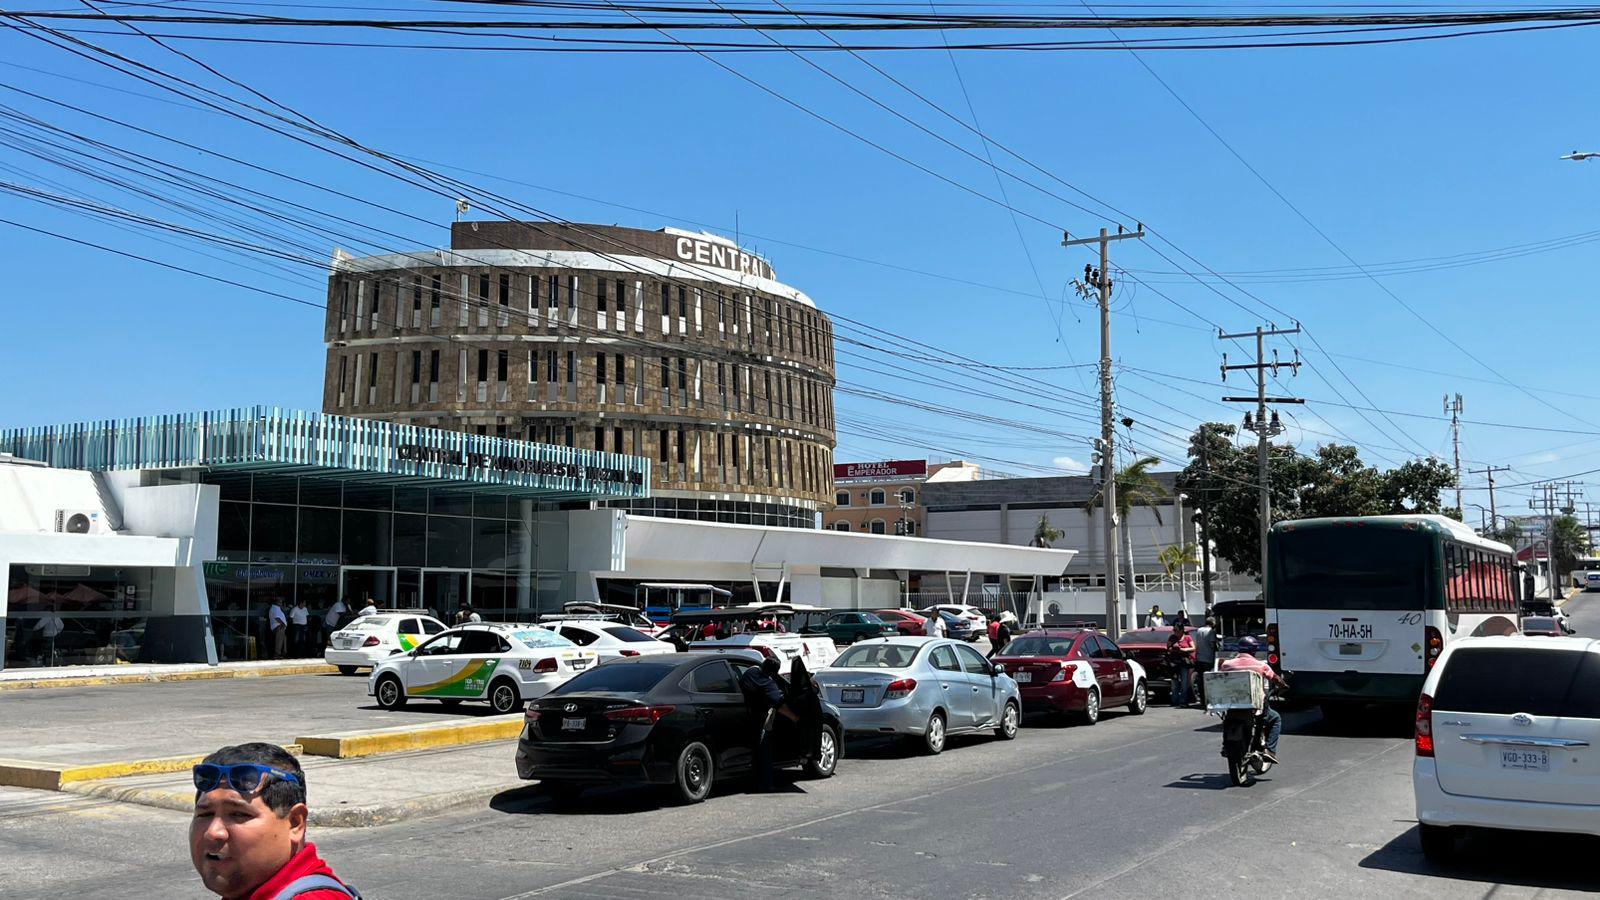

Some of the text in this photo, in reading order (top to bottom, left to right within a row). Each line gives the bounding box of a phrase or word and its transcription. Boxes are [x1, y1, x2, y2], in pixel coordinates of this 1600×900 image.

[676, 237, 764, 278] CENTRAL
[397, 444, 467, 467] CENTRAL
[468, 451, 490, 470] DE
[491, 454, 567, 477] AUTOBUSES
[567, 463, 586, 480] DE
[847, 468, 897, 477] EMPERADOR
[1397, 613, 1422, 625] 40
[1328, 624, 1373, 638] 70-HA-5H
[1503, 752, 1547, 765] VGD-333-B
